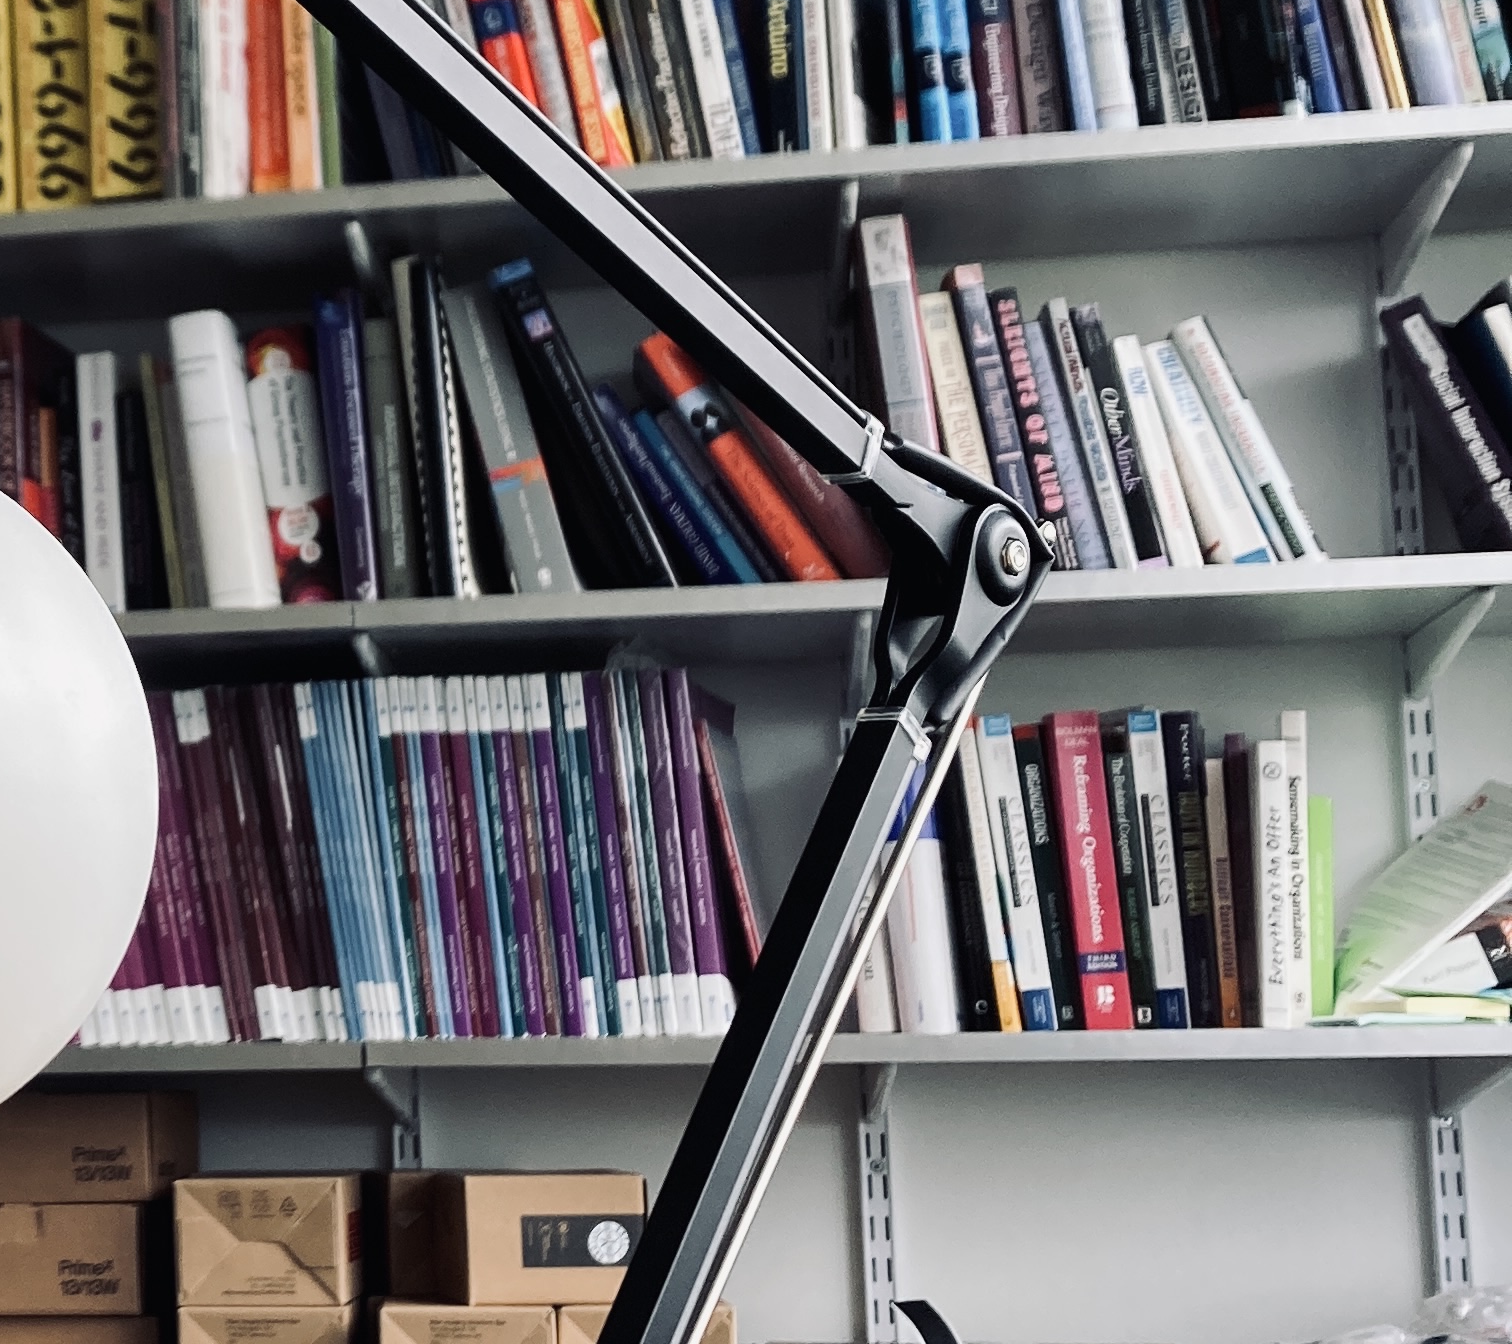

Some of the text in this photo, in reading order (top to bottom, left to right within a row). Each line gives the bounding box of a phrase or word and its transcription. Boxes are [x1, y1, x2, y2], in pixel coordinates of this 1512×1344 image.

[1174, 45, 1203, 123] DESIG
[997, 298, 1039, 407] SLEIGHTS
[1025, 414, 1049, 444] OF
[1114, 434, 1145, 495] Minds
[1033, 454, 1064, 513] MIND
[1025, 762, 1050, 846] ORGANIZATIONS
[1266, 805, 1283, 851] Offer
[1007, 795, 1037, 906] CLASSICS
[1074, 754, 1106, 944] Reframing Organizations
[1150, 793, 1175, 906] CLASSICS
